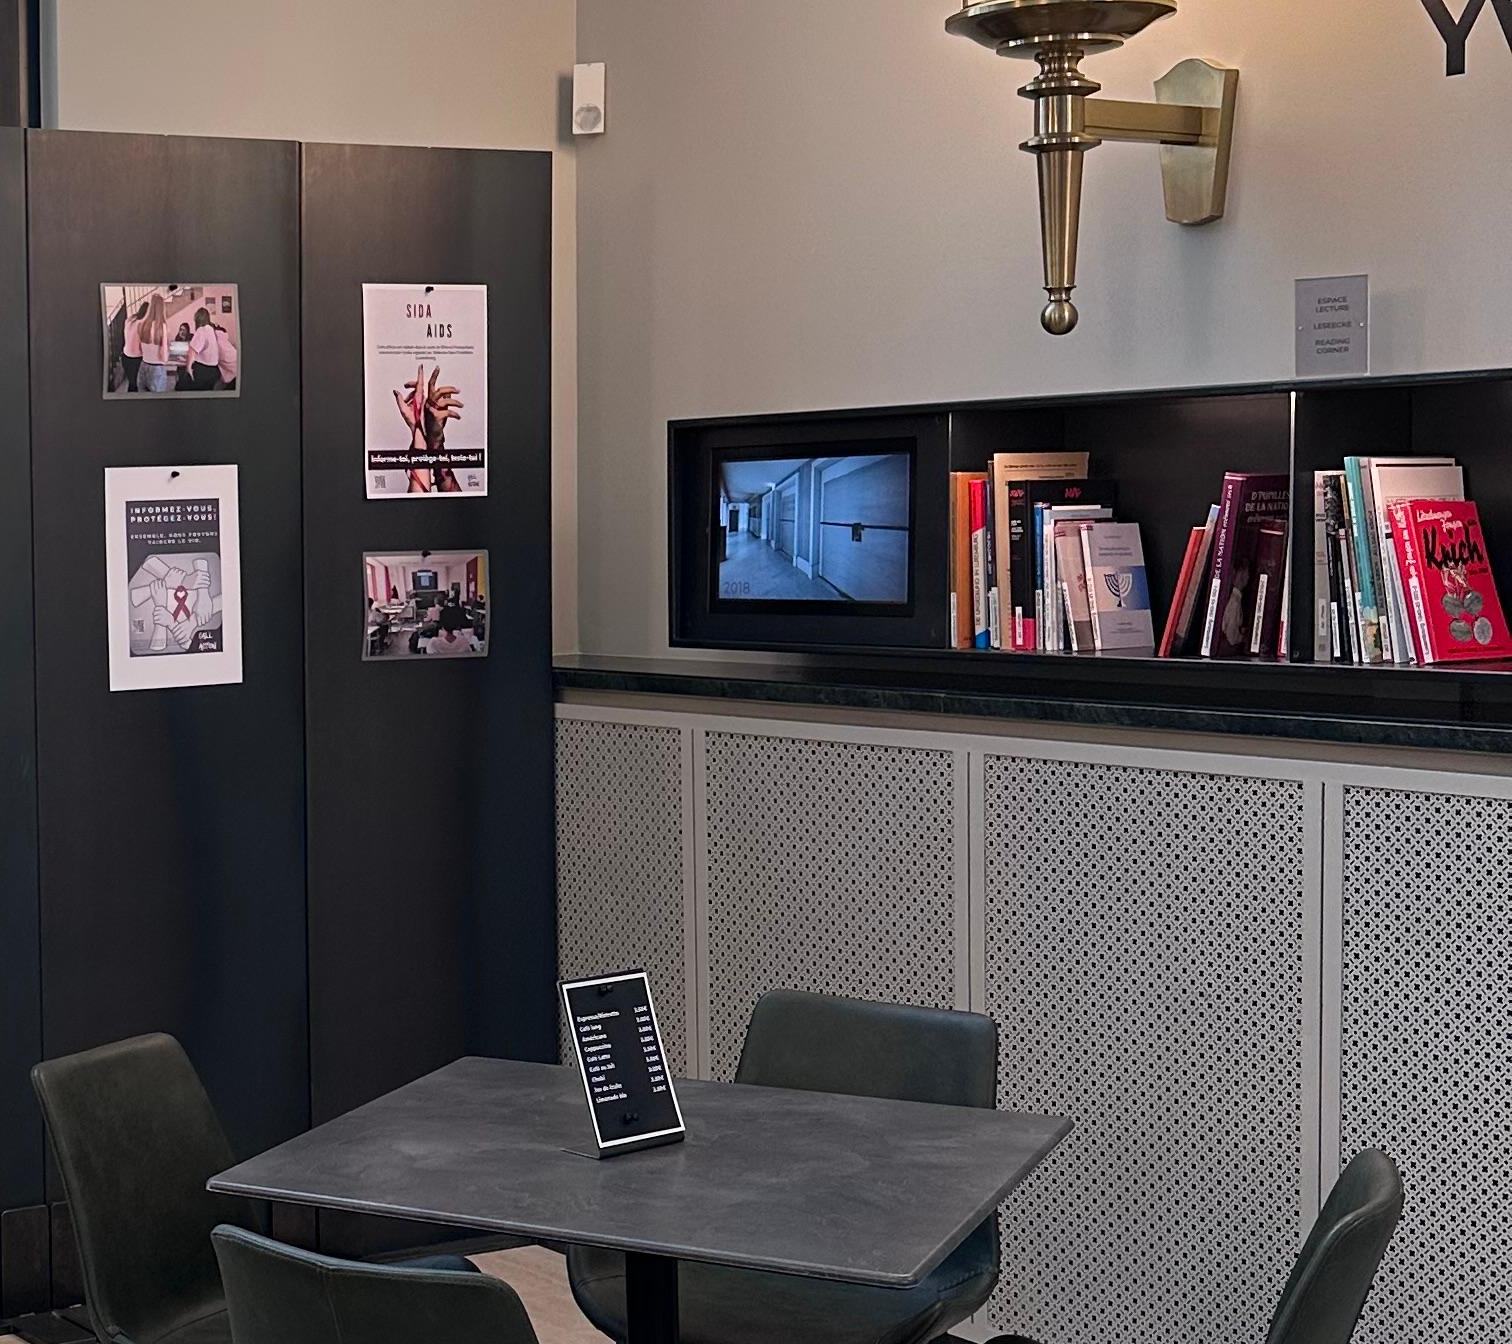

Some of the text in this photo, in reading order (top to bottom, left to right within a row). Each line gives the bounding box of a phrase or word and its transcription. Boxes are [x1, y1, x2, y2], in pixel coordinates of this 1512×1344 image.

[1317, 296, 1348, 304] ESPACE
[406, 304, 432, 318] SIDA
[1315, 304, 1349, 313] LECTURE
[1313, 321, 1352, 329] LESEECKE
[426, 324, 453, 338] AIDS
[1315, 337, 1350, 346] READING
[1316, 346, 1349, 354] CORNER
[724, 581, 750, 595] 2018
